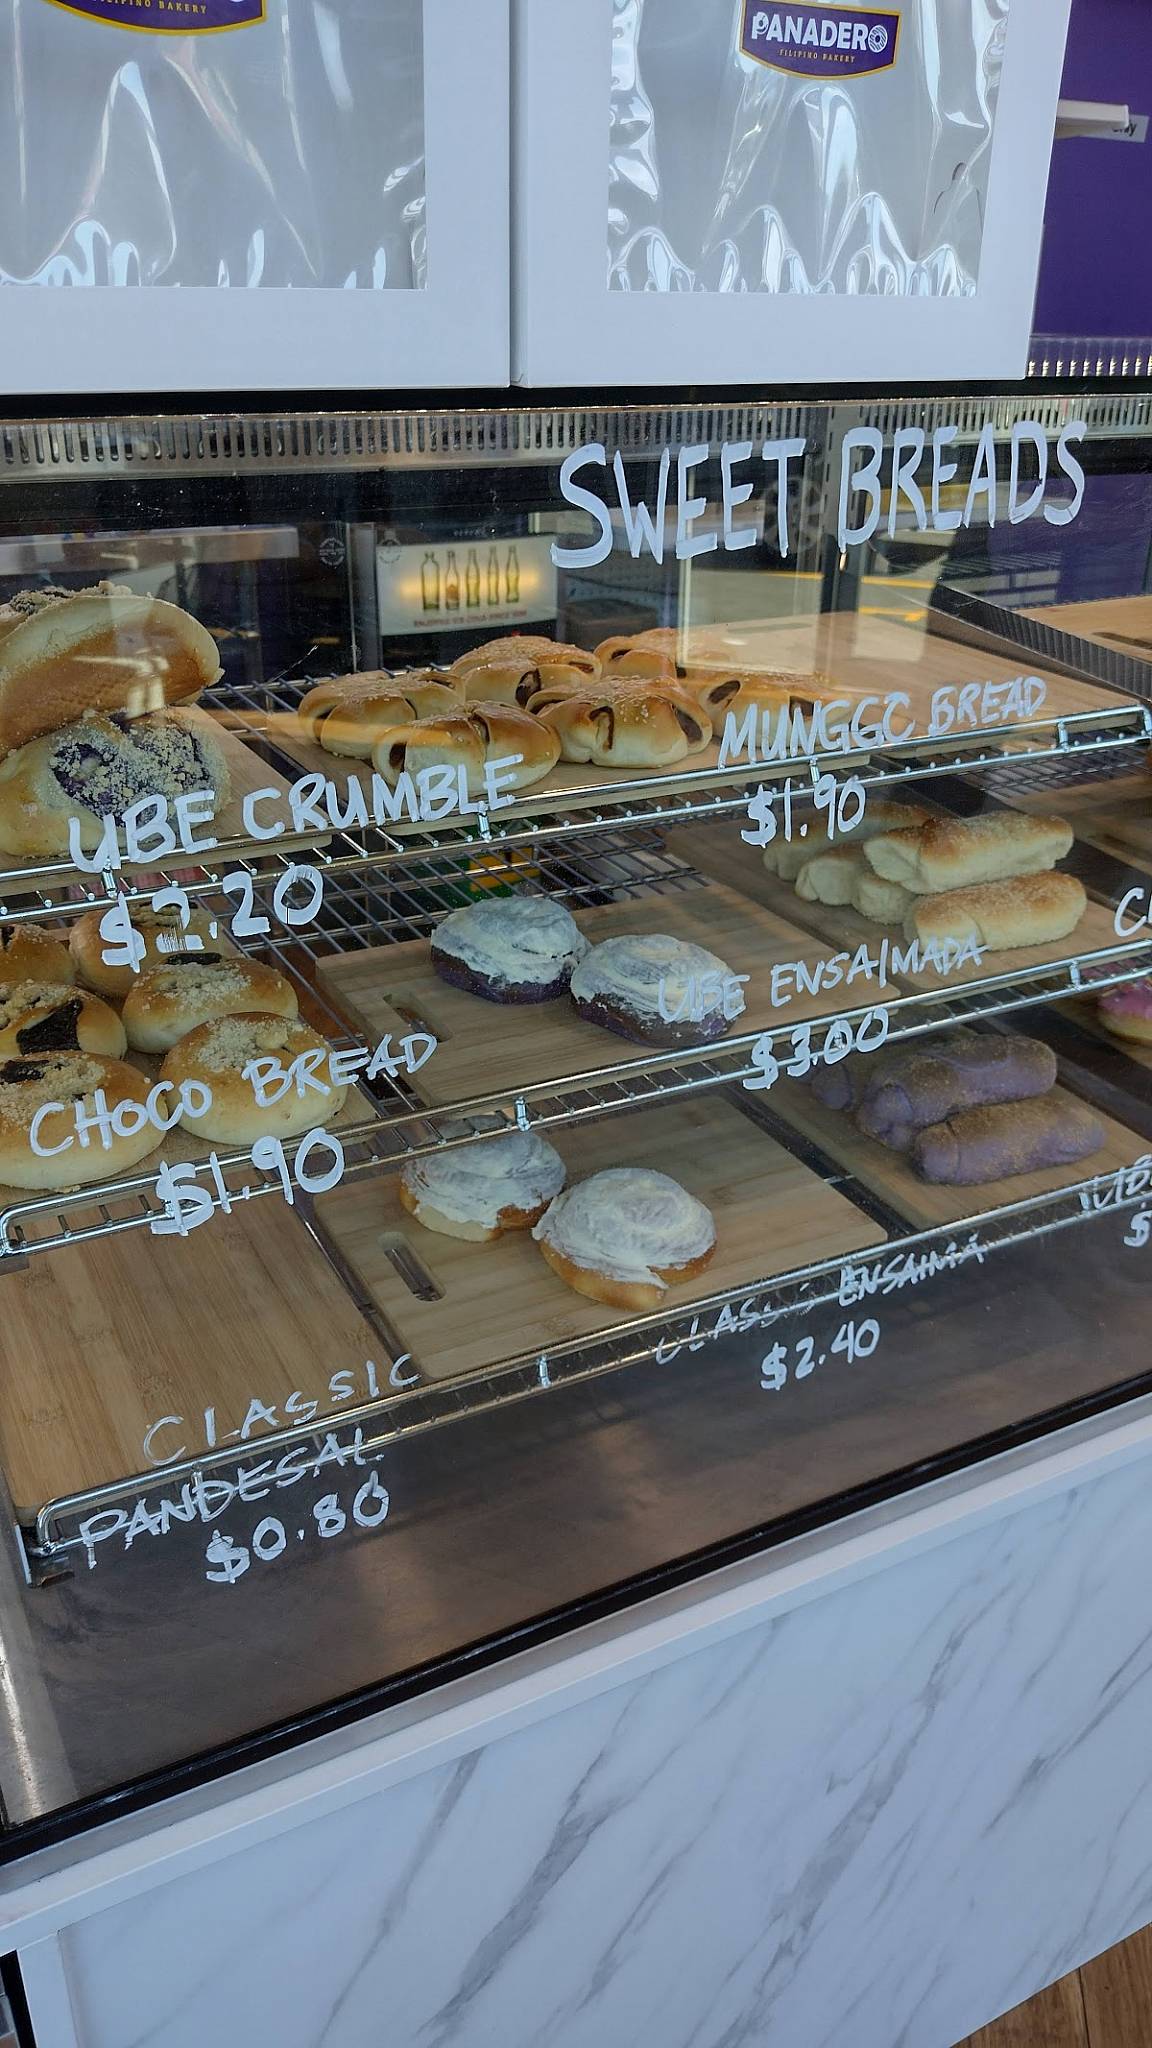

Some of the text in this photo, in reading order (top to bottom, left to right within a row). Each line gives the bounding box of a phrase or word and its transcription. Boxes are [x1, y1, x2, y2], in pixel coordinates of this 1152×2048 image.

[159, 2, 207, 14] BAKERY
[751, 11, 888, 53] PANADERO
[779, 48, 818, 60] FILIPINO
[550, 420, 1087, 569] SWEET BREADS
[928, 675, 1046, 737] BREAD
[69, 754, 524, 873] UBE CRUMBLE
[741, 773, 866, 849] $1.90
[100, 864, 324, 973] $2.20
[771, 931, 990, 1007] ENSAIMADA
[743, 1006, 889, 1090] $3.00
[30, 1032, 438, 1156] CHOCO BREAD
[151, 1127, 345, 1237] $1.90
[761, 1318, 880, 1390] $2.40
[79, 1427, 385, 1569] PANDESAL
[206, 1471, 390, 1584] $0.80
